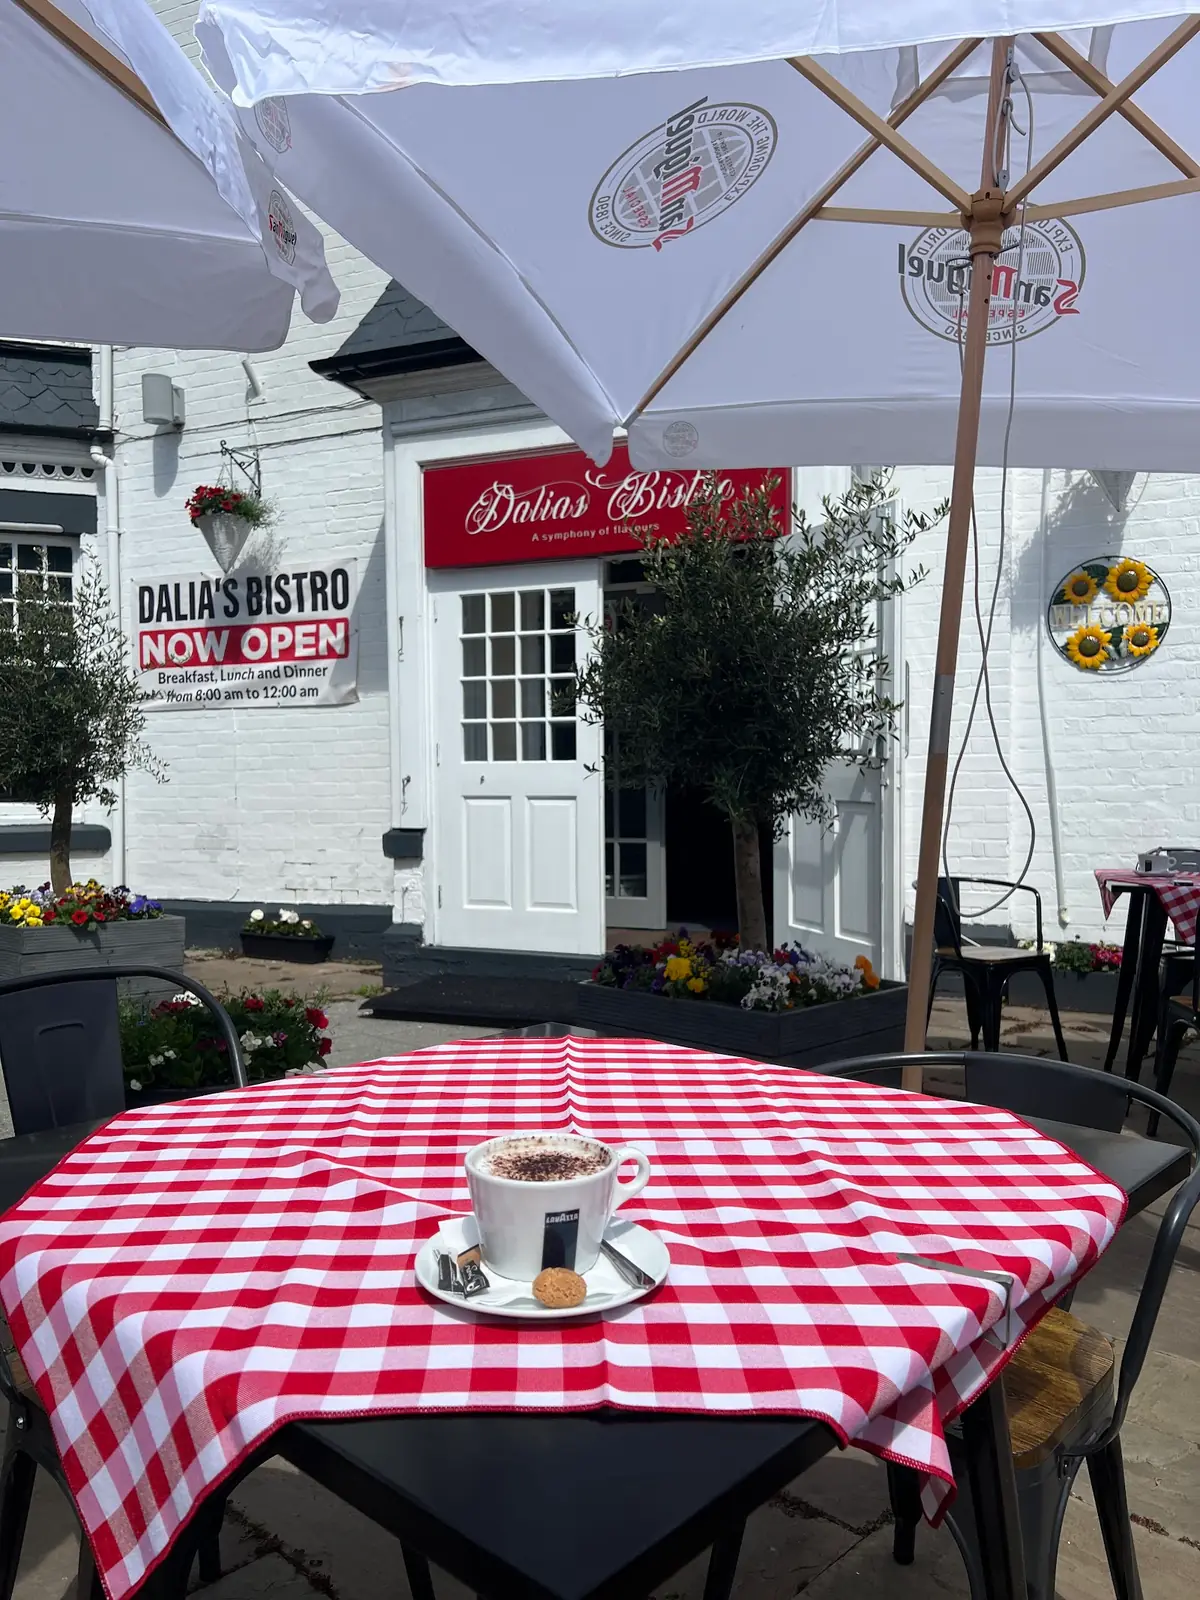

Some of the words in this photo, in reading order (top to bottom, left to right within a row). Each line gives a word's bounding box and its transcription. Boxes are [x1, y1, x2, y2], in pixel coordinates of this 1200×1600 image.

[465, 481, 591, 535] Dalias
[531, 533, 540, 542] A
[541, 530, 595, 543] symphony
[598, 526, 610, 537] of
[138, 577, 240, 624] DALIA'S
[246, 567, 349, 617] BISTRO
[1051, 600, 1169, 629] WELCOME
[141, 629, 230, 665] NOW
[241, 621, 346, 660] OPEN
[157, 669, 218, 685] Breakfast,
[220, 667, 255, 682] Lunch
[257, 666, 281, 680] and
[284, 664, 328, 679] Dinner
[167, 689, 193, 703] from
[195, 688, 222, 702] 8:00
[224, 689, 243, 700] am
[246, 687, 259, 699] to
[262, 685, 297, 699] 12:00
[299, 687, 319, 697] am
